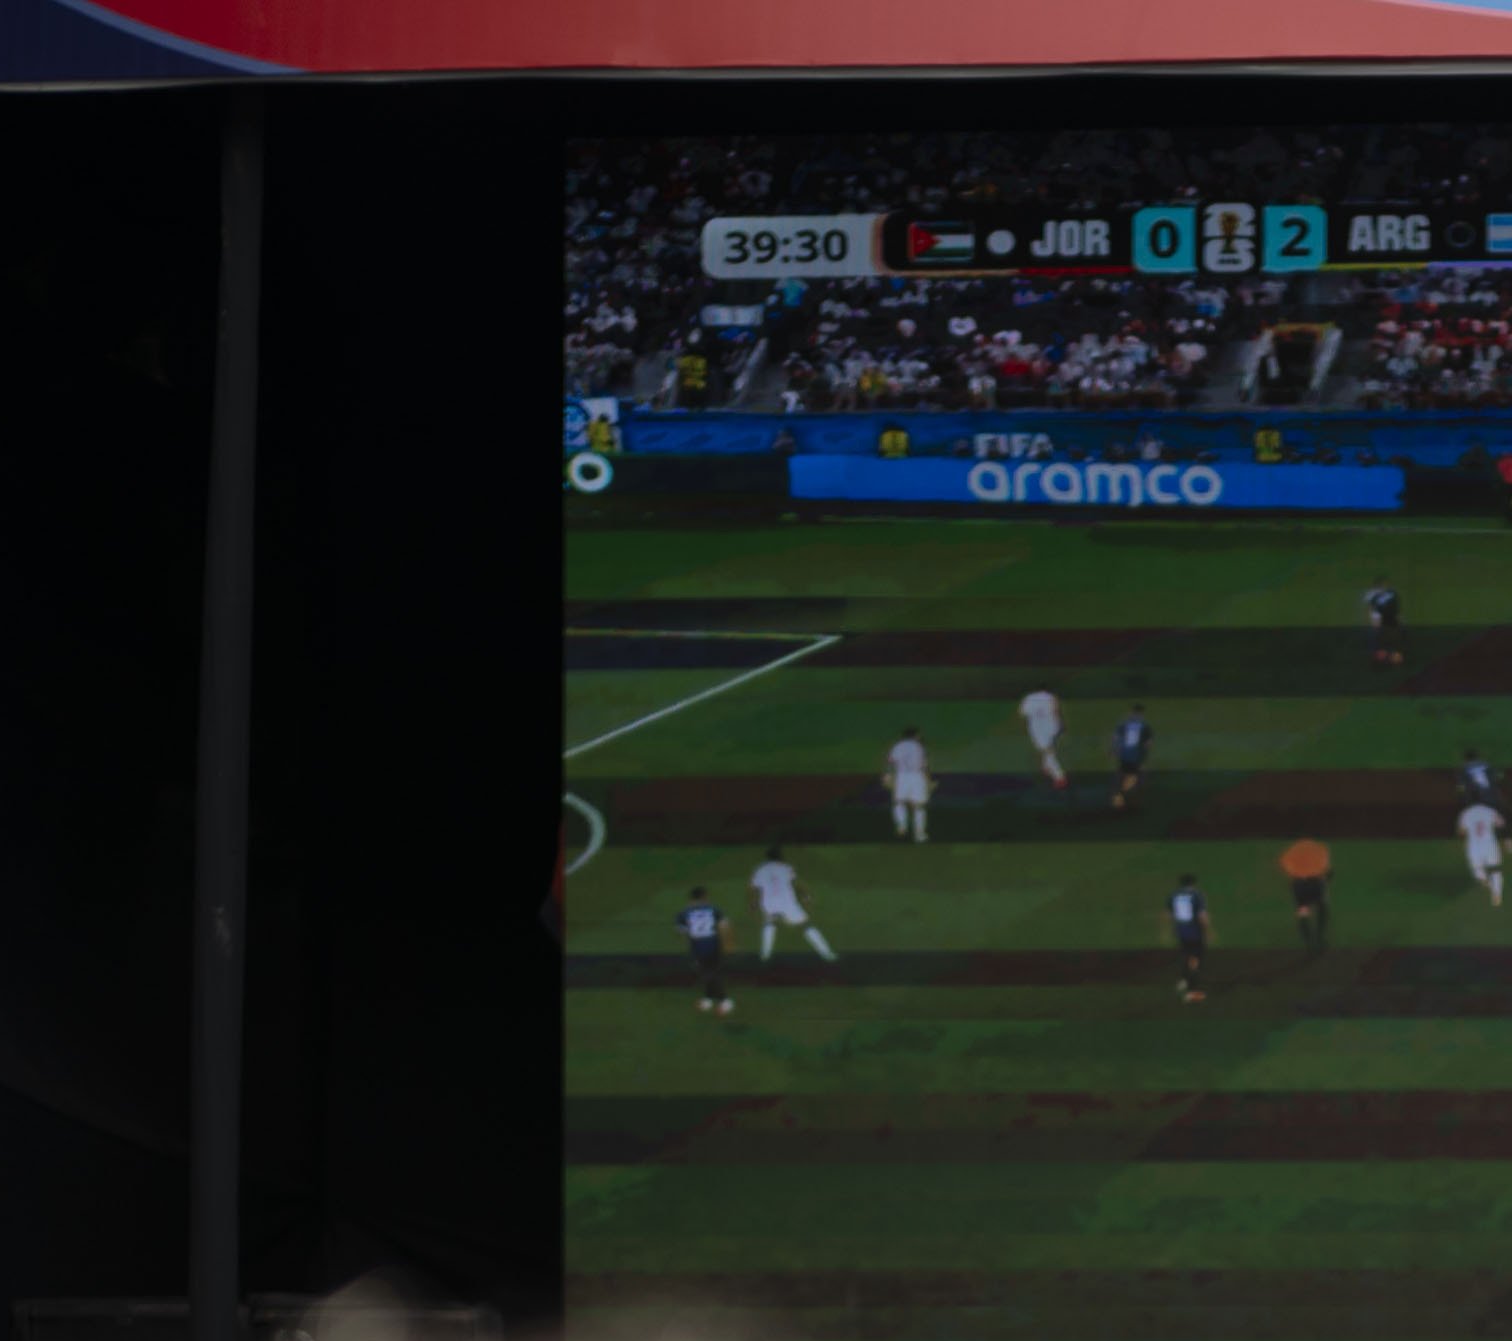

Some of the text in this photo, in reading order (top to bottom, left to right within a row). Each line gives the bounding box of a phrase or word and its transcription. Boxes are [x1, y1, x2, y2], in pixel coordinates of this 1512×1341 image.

[723, 229, 849, 264] 39:30
[1031, 220, 1112, 259] JOR
[1150, 219, 1180, 258] 0
[1281, 218, 1311, 257] 2
[1349, 215, 1432, 252] ARG
[967, 462, 1224, 505] aramco
